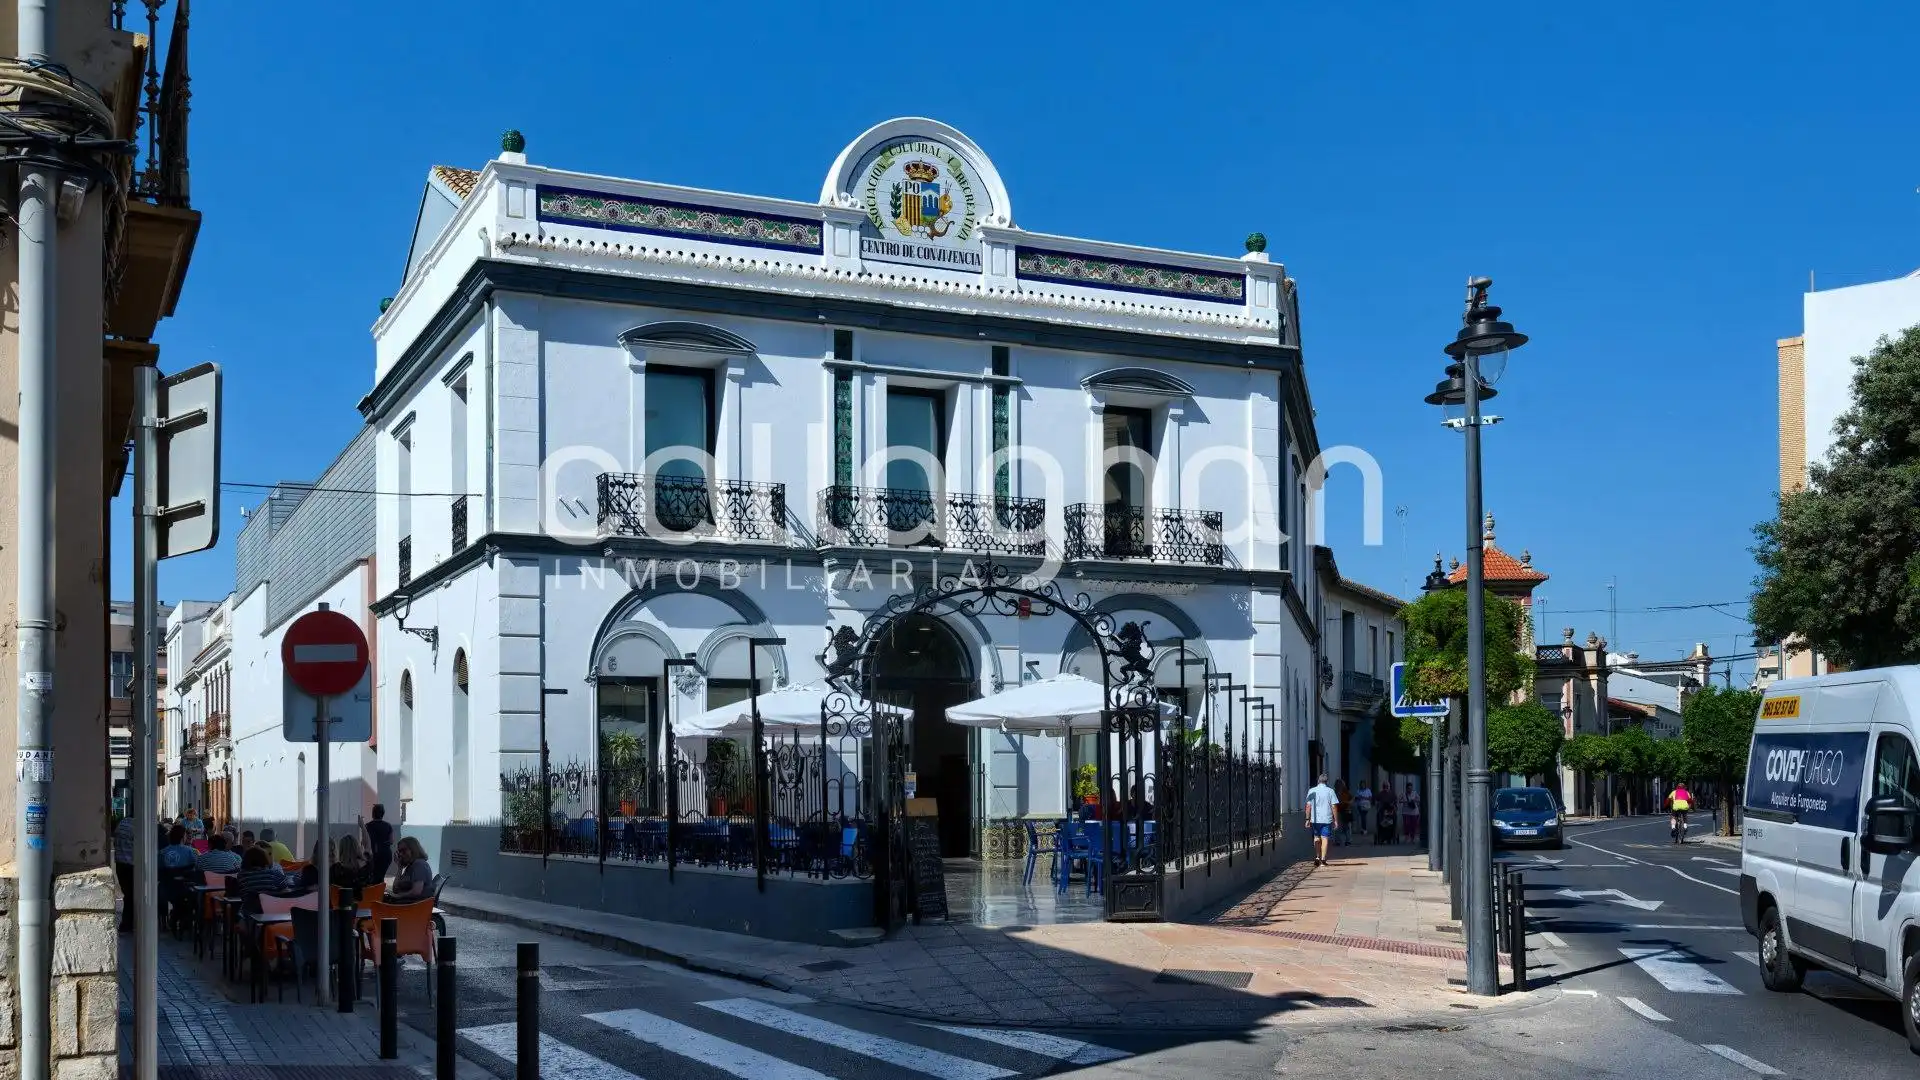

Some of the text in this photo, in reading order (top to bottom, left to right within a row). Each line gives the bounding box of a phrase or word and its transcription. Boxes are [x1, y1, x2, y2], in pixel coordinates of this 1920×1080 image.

[888, 142, 942, 159] CULTURAL
[861, 238, 982, 267] CENTRO DE CONVIVENCIA
[1771, 792, 1827, 812] Alquiler de Furgonetas
